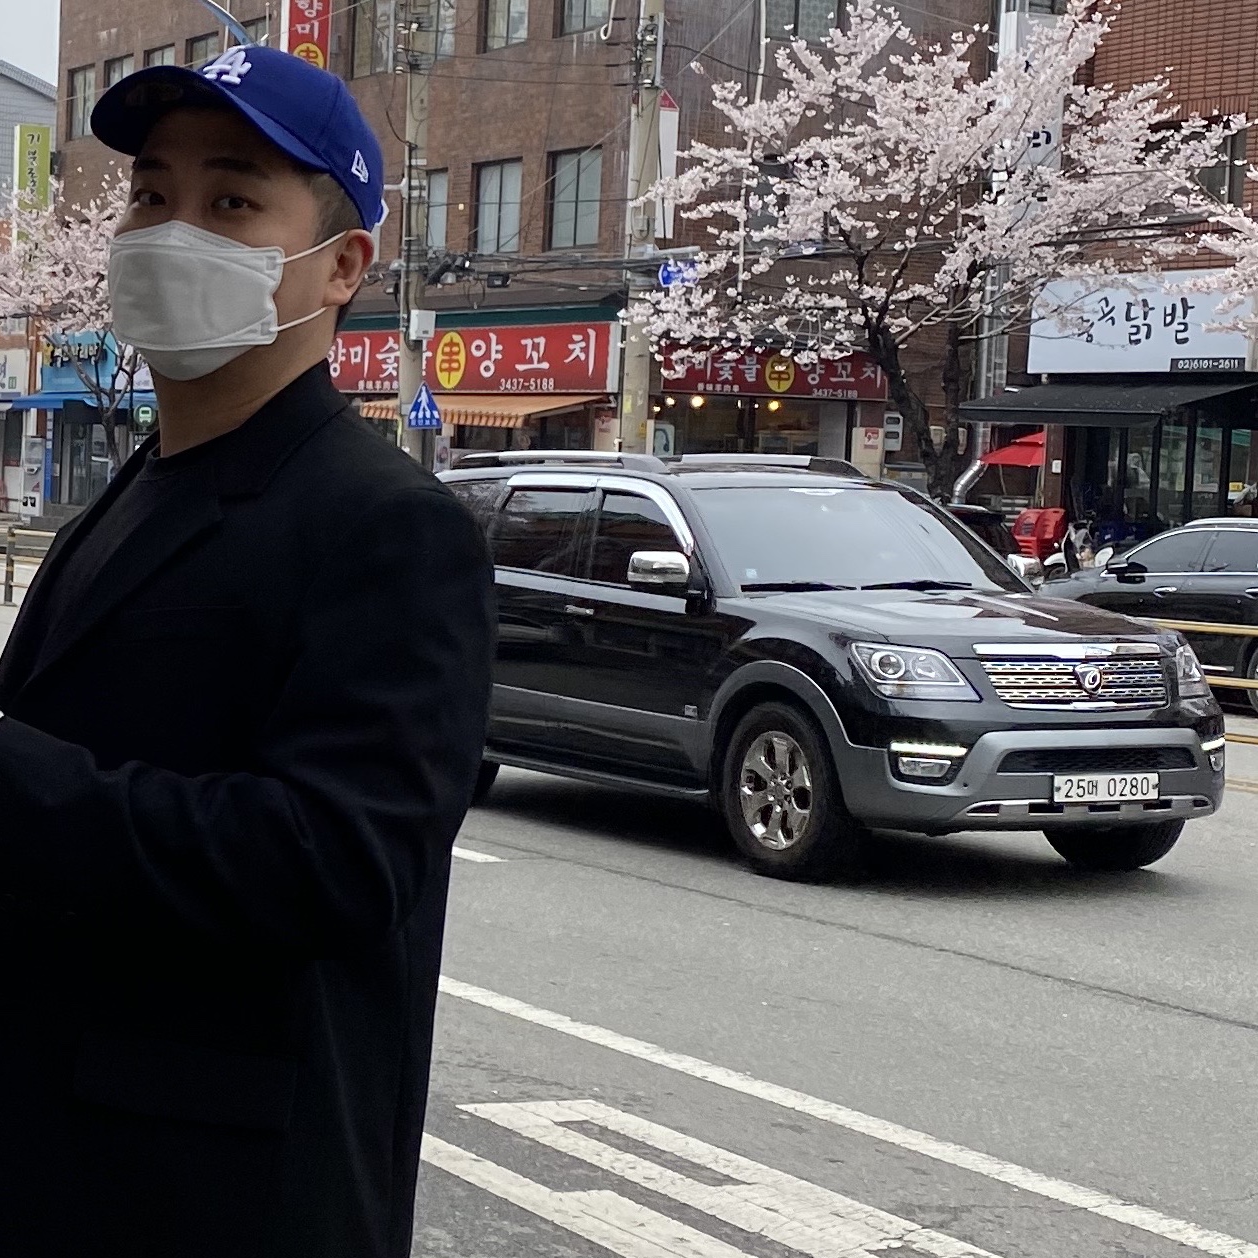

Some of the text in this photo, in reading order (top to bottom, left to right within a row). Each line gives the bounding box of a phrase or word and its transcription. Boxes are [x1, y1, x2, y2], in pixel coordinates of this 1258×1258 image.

[326, 336, 434, 378] 향미숯
[499, 377, 555, 391] 3437-5188
[1107, 776, 1150, 797] 0280
